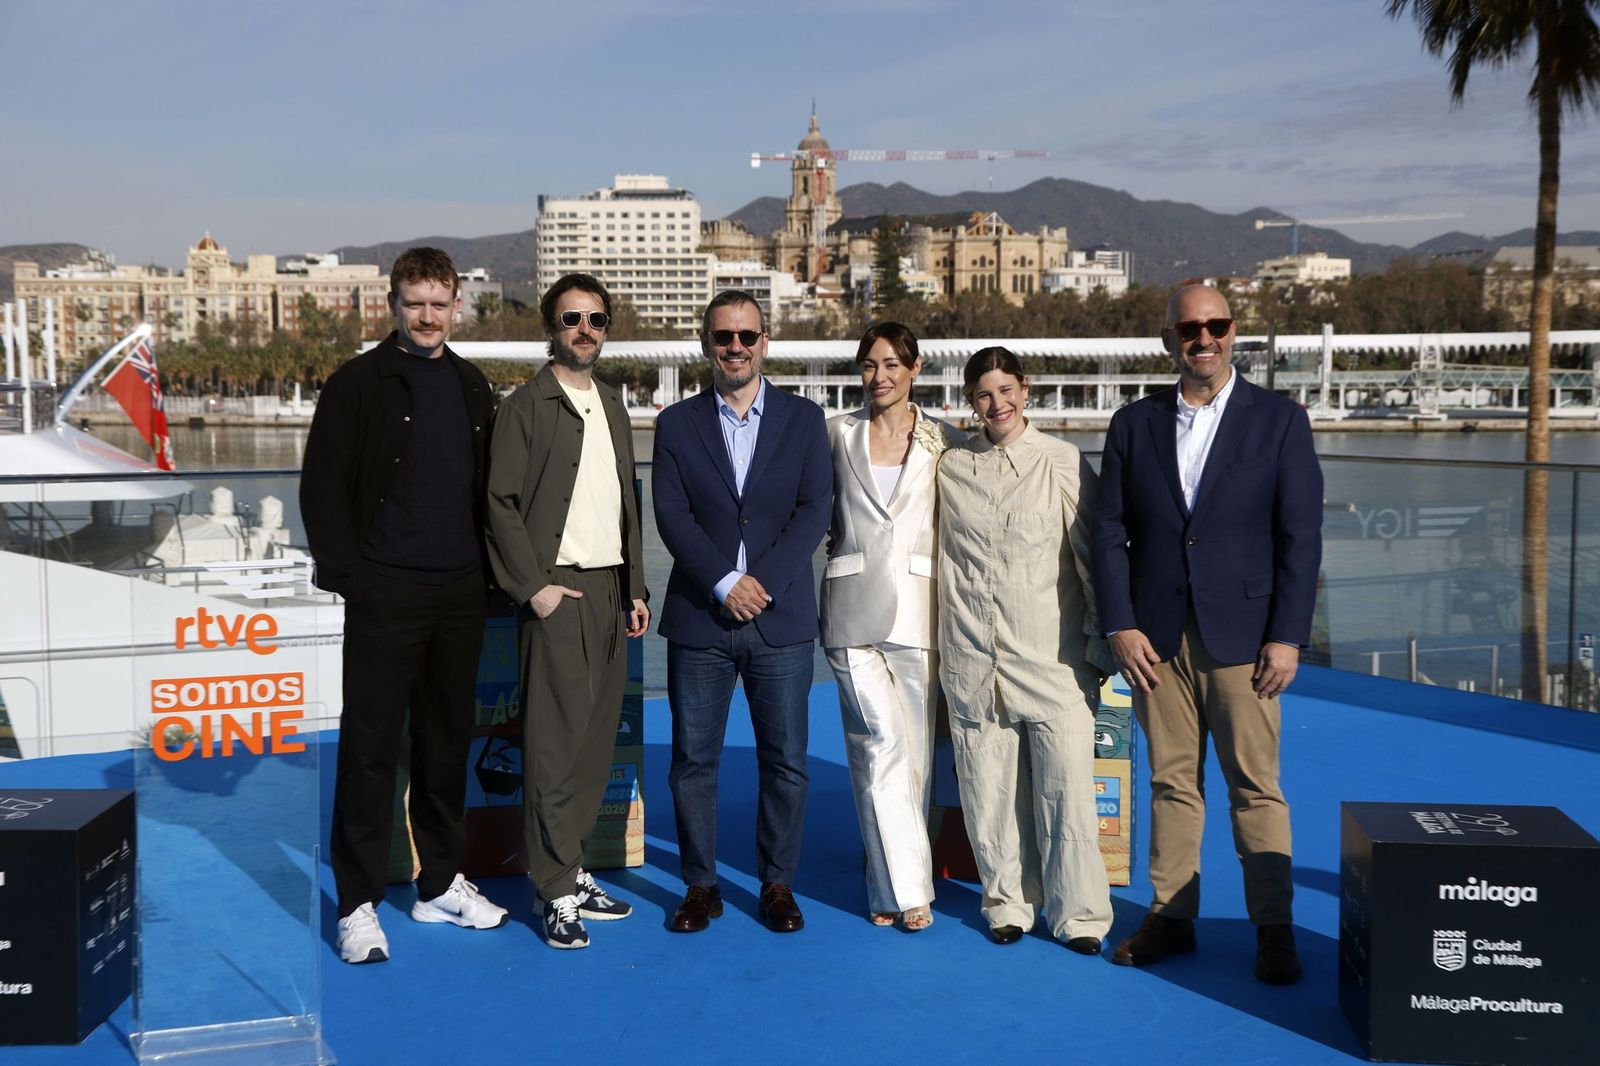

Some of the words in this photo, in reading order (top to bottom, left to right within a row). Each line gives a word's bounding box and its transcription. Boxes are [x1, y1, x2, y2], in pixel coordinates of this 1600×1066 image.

[175, 607, 278, 655] rtve
[152, 676, 302, 709] somos
[151, 710, 306, 762] CINE
[1472, 938, 1522, 952] Ciudad
[1472, 953, 1491, 966] de
[1493, 954, 1543, 969] Málaga
[1410, 994, 1564, 1014] MálagaProcultura
